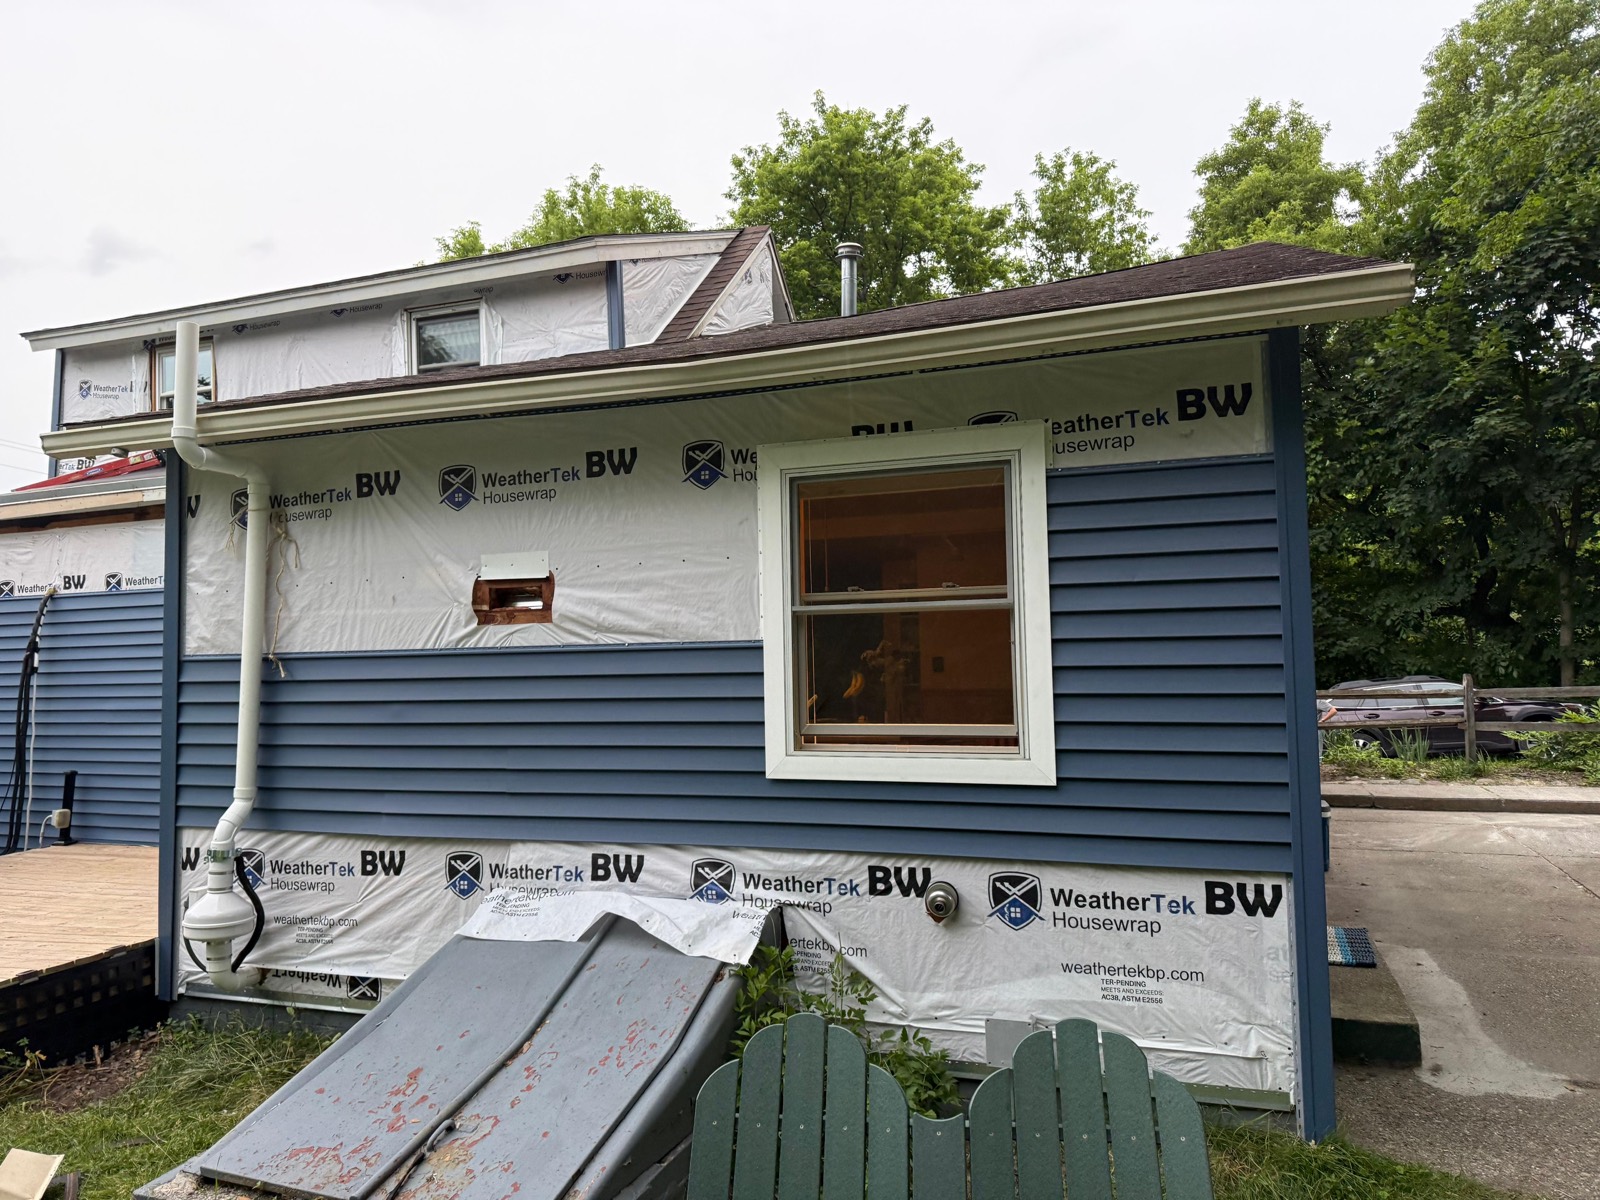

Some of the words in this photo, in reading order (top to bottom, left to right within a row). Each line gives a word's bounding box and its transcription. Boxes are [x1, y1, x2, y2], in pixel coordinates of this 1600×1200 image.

[350, 303, 383, 313] Housewrap
[250, 320, 281, 331] Housewrap
[92, 392, 120, 401] Housewrap
[93, 384, 129, 394] WeatherTek
[1045, 406, 1170, 435] eatherTek
[1176, 382, 1252, 422] BW
[1052, 434, 1135, 455] usewrap
[481, 466, 581, 489] WeatherTek
[585, 447, 637, 479] BW
[269, 487, 352, 509] WeatherTek
[355, 469, 401, 499] BW
[483, 486, 557, 505] Housewrap
[186, 494, 201, 519] W
[17, 583, 52, 594] WeatherT
[63, 574, 86, 590] BW
[125, 575, 164, 587] WeatherT
[181, 847, 200, 872] W
[270, 860, 355, 877] WeatherTek
[360, 850, 406, 876] BW
[590, 852, 645, 883] BW
[270, 877, 335, 895] Housewrap
[742, 872, 861, 897] WeatherTek
[867, 865, 932, 899] BW
[742, 893, 833, 917] Housewrap
[1049, 887, 1197, 916] WeatherTek
[1204, 880, 1283, 919] BW
[273, 914, 359, 929] weathertekbp.com
[1052, 911, 1162, 937] Housewrap
[1060, 961, 1205, 984] weathertekbp.com
[1101, 978, 1147, 988] TER-PENDING
[1101, 993, 1121, 1002] AC38,
[1122, 995, 1141, 1003] ASTM
[1142, 996, 1163, 1004] E2556
[1135, 988, 1164, 996] EXCEEDS:
